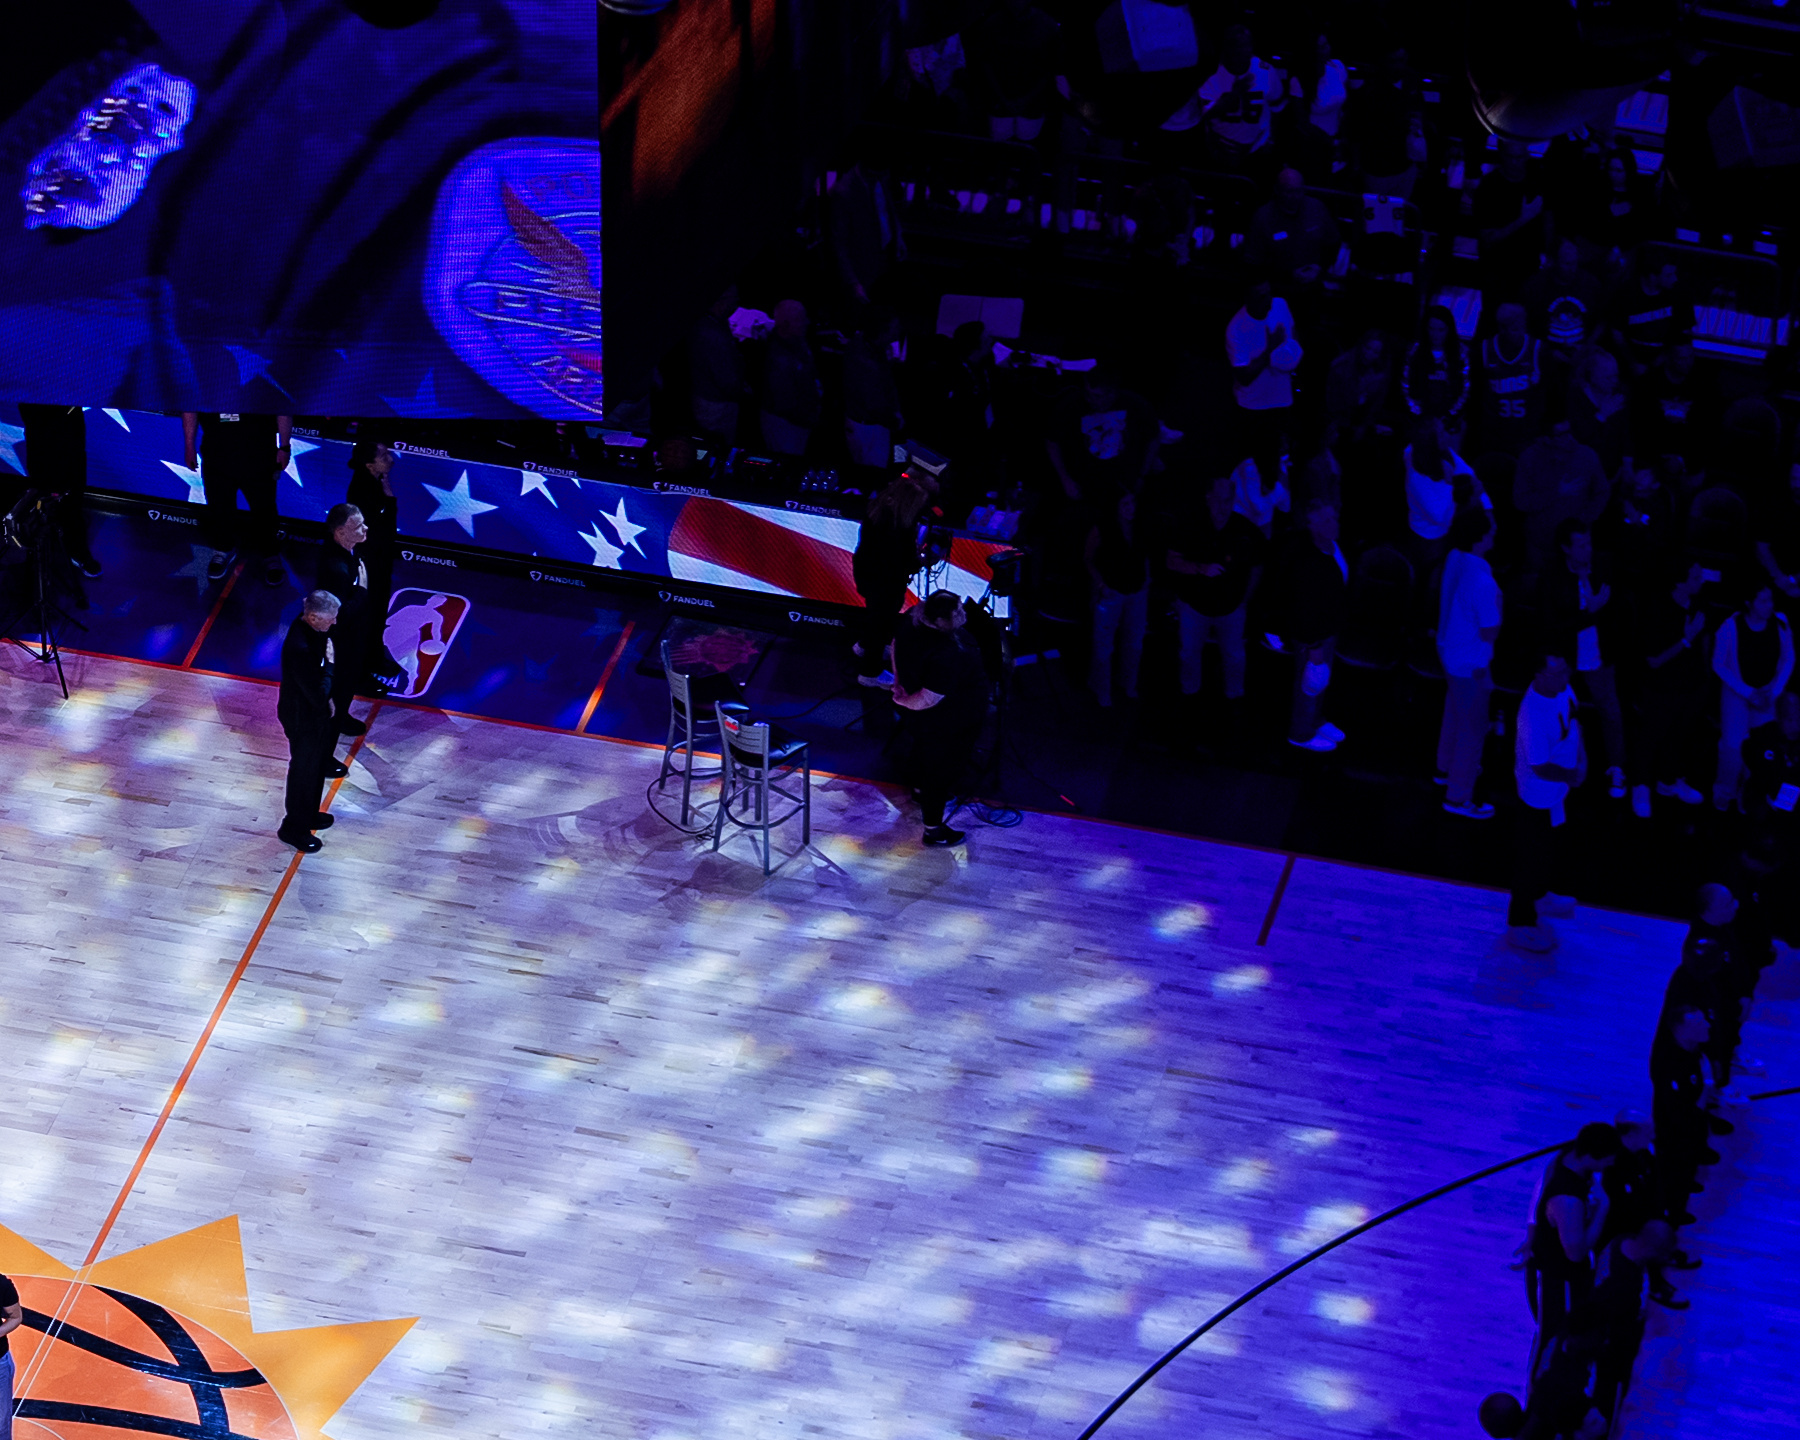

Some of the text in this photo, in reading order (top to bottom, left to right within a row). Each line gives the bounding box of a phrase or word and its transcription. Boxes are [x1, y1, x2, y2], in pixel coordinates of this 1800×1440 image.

[1498, 399, 1527, 418] 35
[408, 445, 450, 457] FANDUEL
[538, 466, 579, 478] FANDUEL
[669, 484, 712, 496] FANDUEL
[803, 504, 843, 517] FANDUEL
[162, 514, 198, 526] FANDUE
[415, 555, 458, 568] FANDUEL
[544, 574, 586, 587] FANDUEL
[673, 595, 715, 608] FANDUEL
[803, 615, 846, 627] FANDUEL
